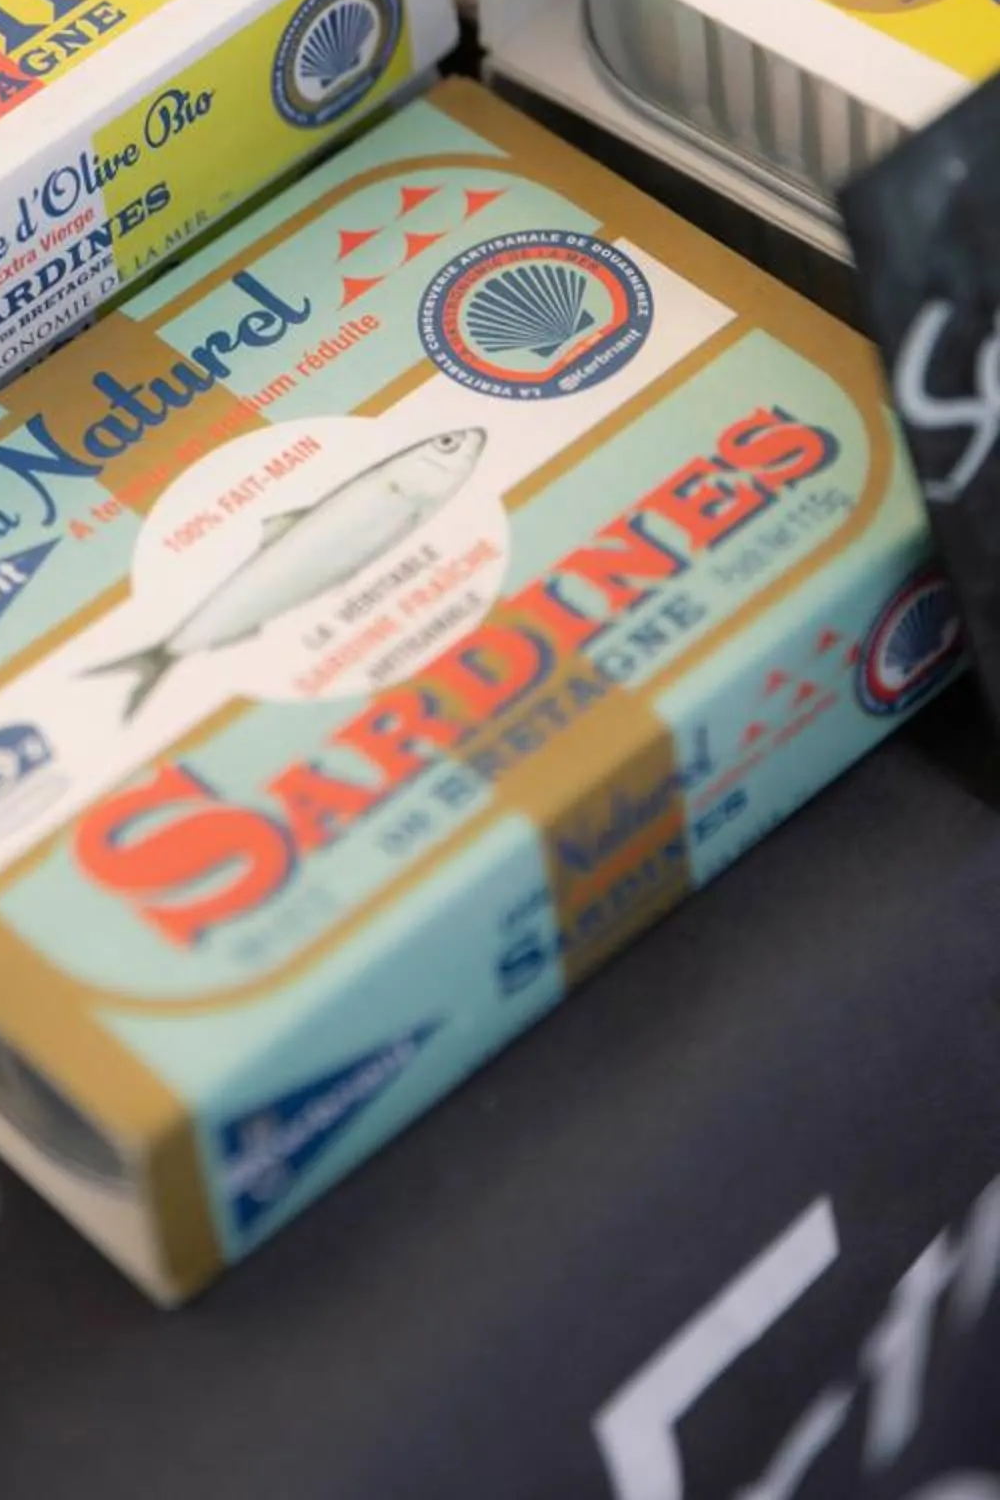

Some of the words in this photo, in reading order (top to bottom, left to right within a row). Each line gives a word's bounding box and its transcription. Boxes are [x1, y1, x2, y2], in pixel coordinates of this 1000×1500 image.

[14, 142, 141, 245] d'Olive
[143, 88, 216, 150] Bio
[39, 206, 96, 255] Vierge
[99, 268, 127, 297] DE
[133, 246, 159, 271] LA
[163, 208, 211, 247] MER
[459, 231, 561, 266] ARTISANALE
[565, 233, 589, 248] DE
[18, 252, 114, 330] BRETAGNE
[420, 263, 459, 352] CONSERVERIE
[590, 241, 650, 317] DOUARNENEZ
[296, 311, 381, 378] réduite
[570, 328, 643, 389] Kerbriant
[517, 387, 542, 398] LA
[217, 434, 323, 514] FAIT-MAIN
[69, 402, 841, 952] SARDINES
[430, 593, 705, 807] BRETAGNE
